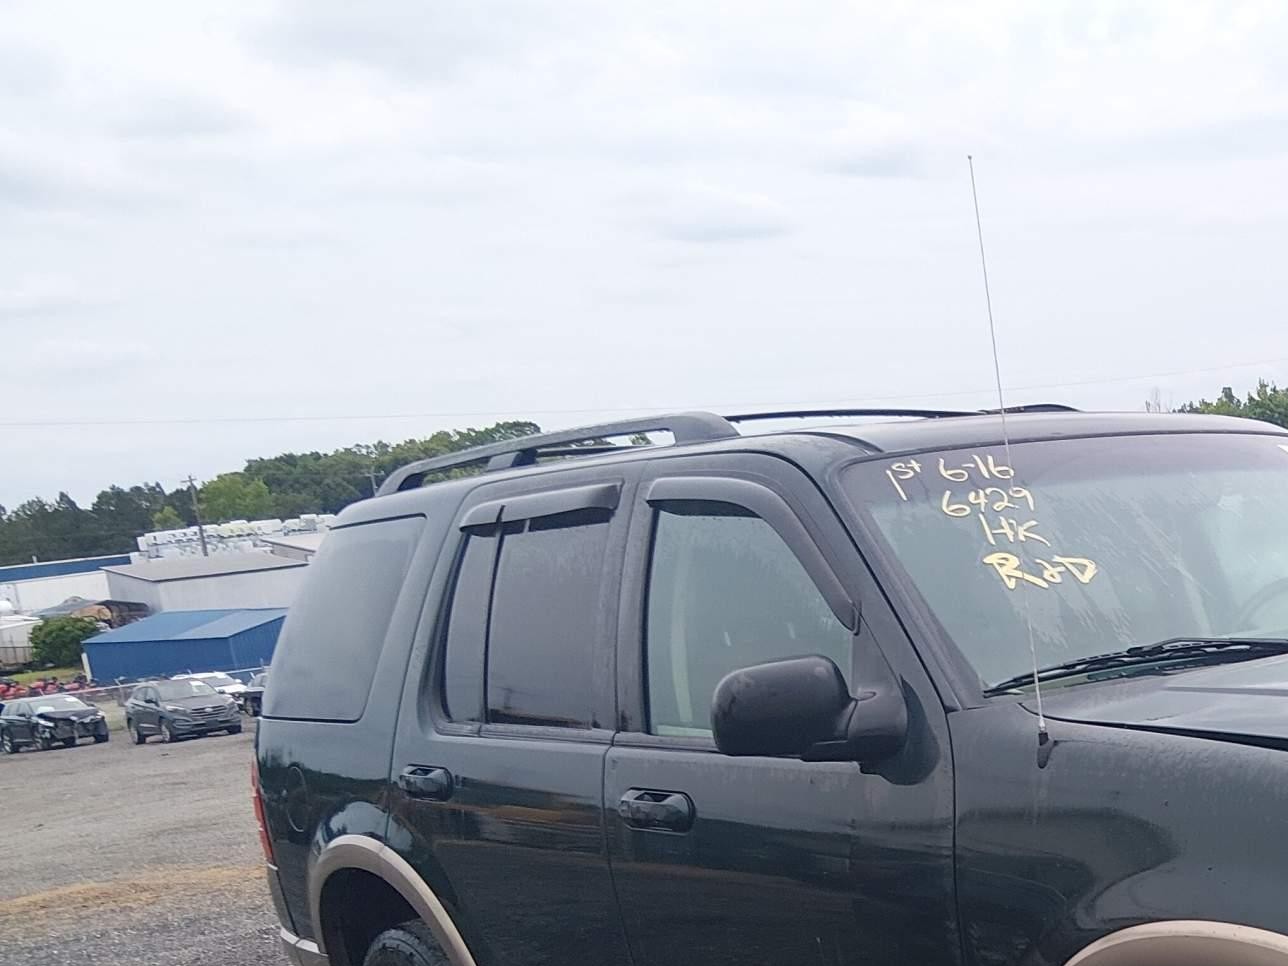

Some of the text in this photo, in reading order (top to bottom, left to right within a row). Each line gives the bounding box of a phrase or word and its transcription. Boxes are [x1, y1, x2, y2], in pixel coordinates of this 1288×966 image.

[938, 455, 1015, 482] 6-16
[942, 487, 1035, 516] 6429
[979, 514, 1051, 546] HK
